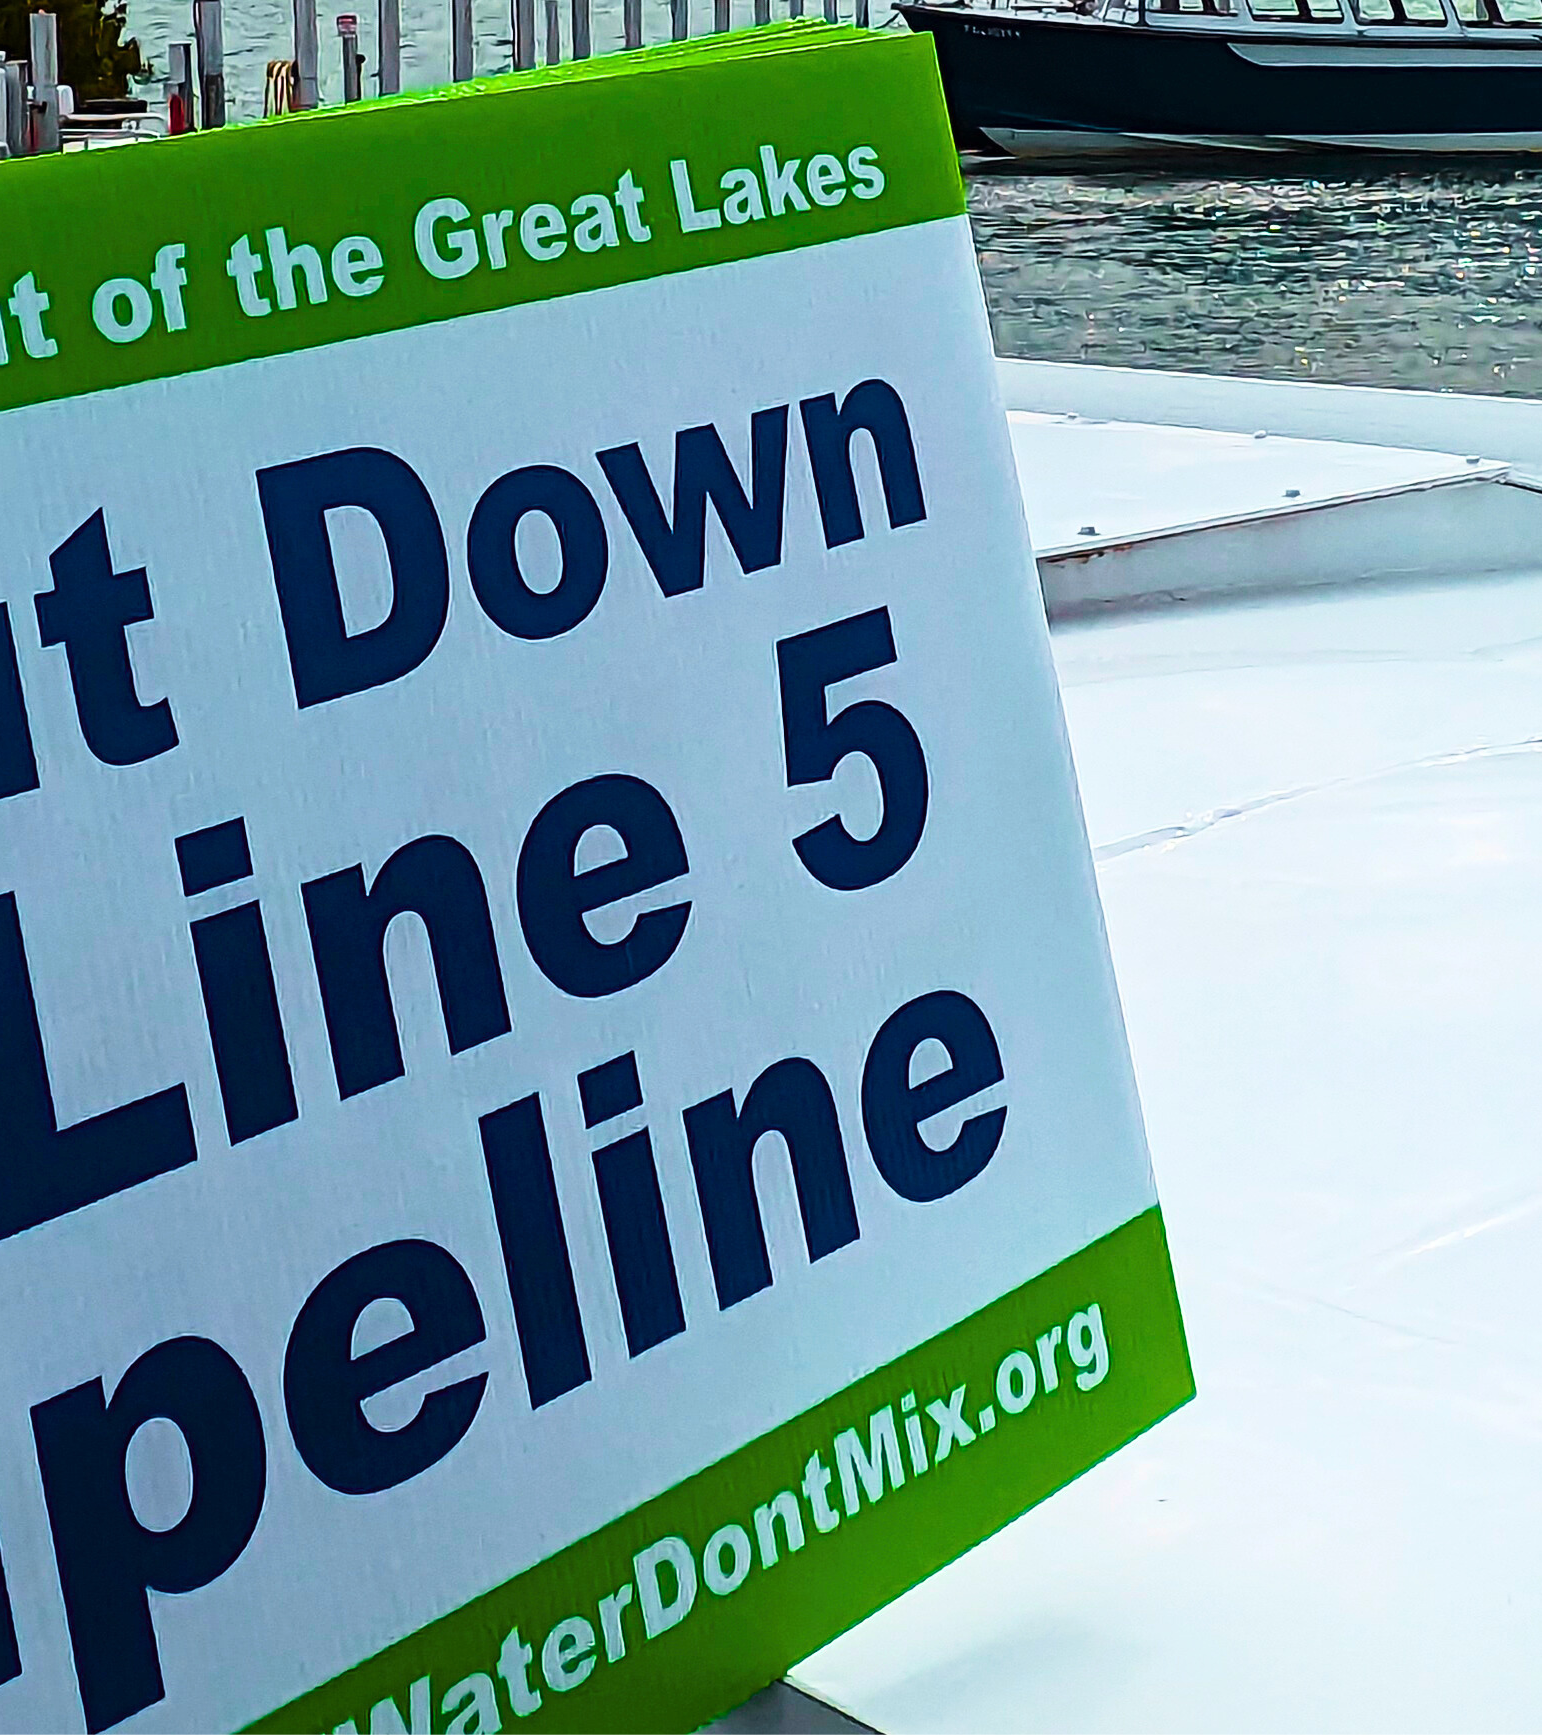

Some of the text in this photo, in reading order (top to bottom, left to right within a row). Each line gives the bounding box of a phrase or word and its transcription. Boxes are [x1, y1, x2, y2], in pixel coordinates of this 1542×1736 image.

[93, 244, 187, 342] of
[227, 228, 383, 316] the
[415, 171, 651, 279] Great
[671, 146, 886, 231] Lakes
[256, 373, 926, 709] Down
[777, 606, 928, 890] 5
